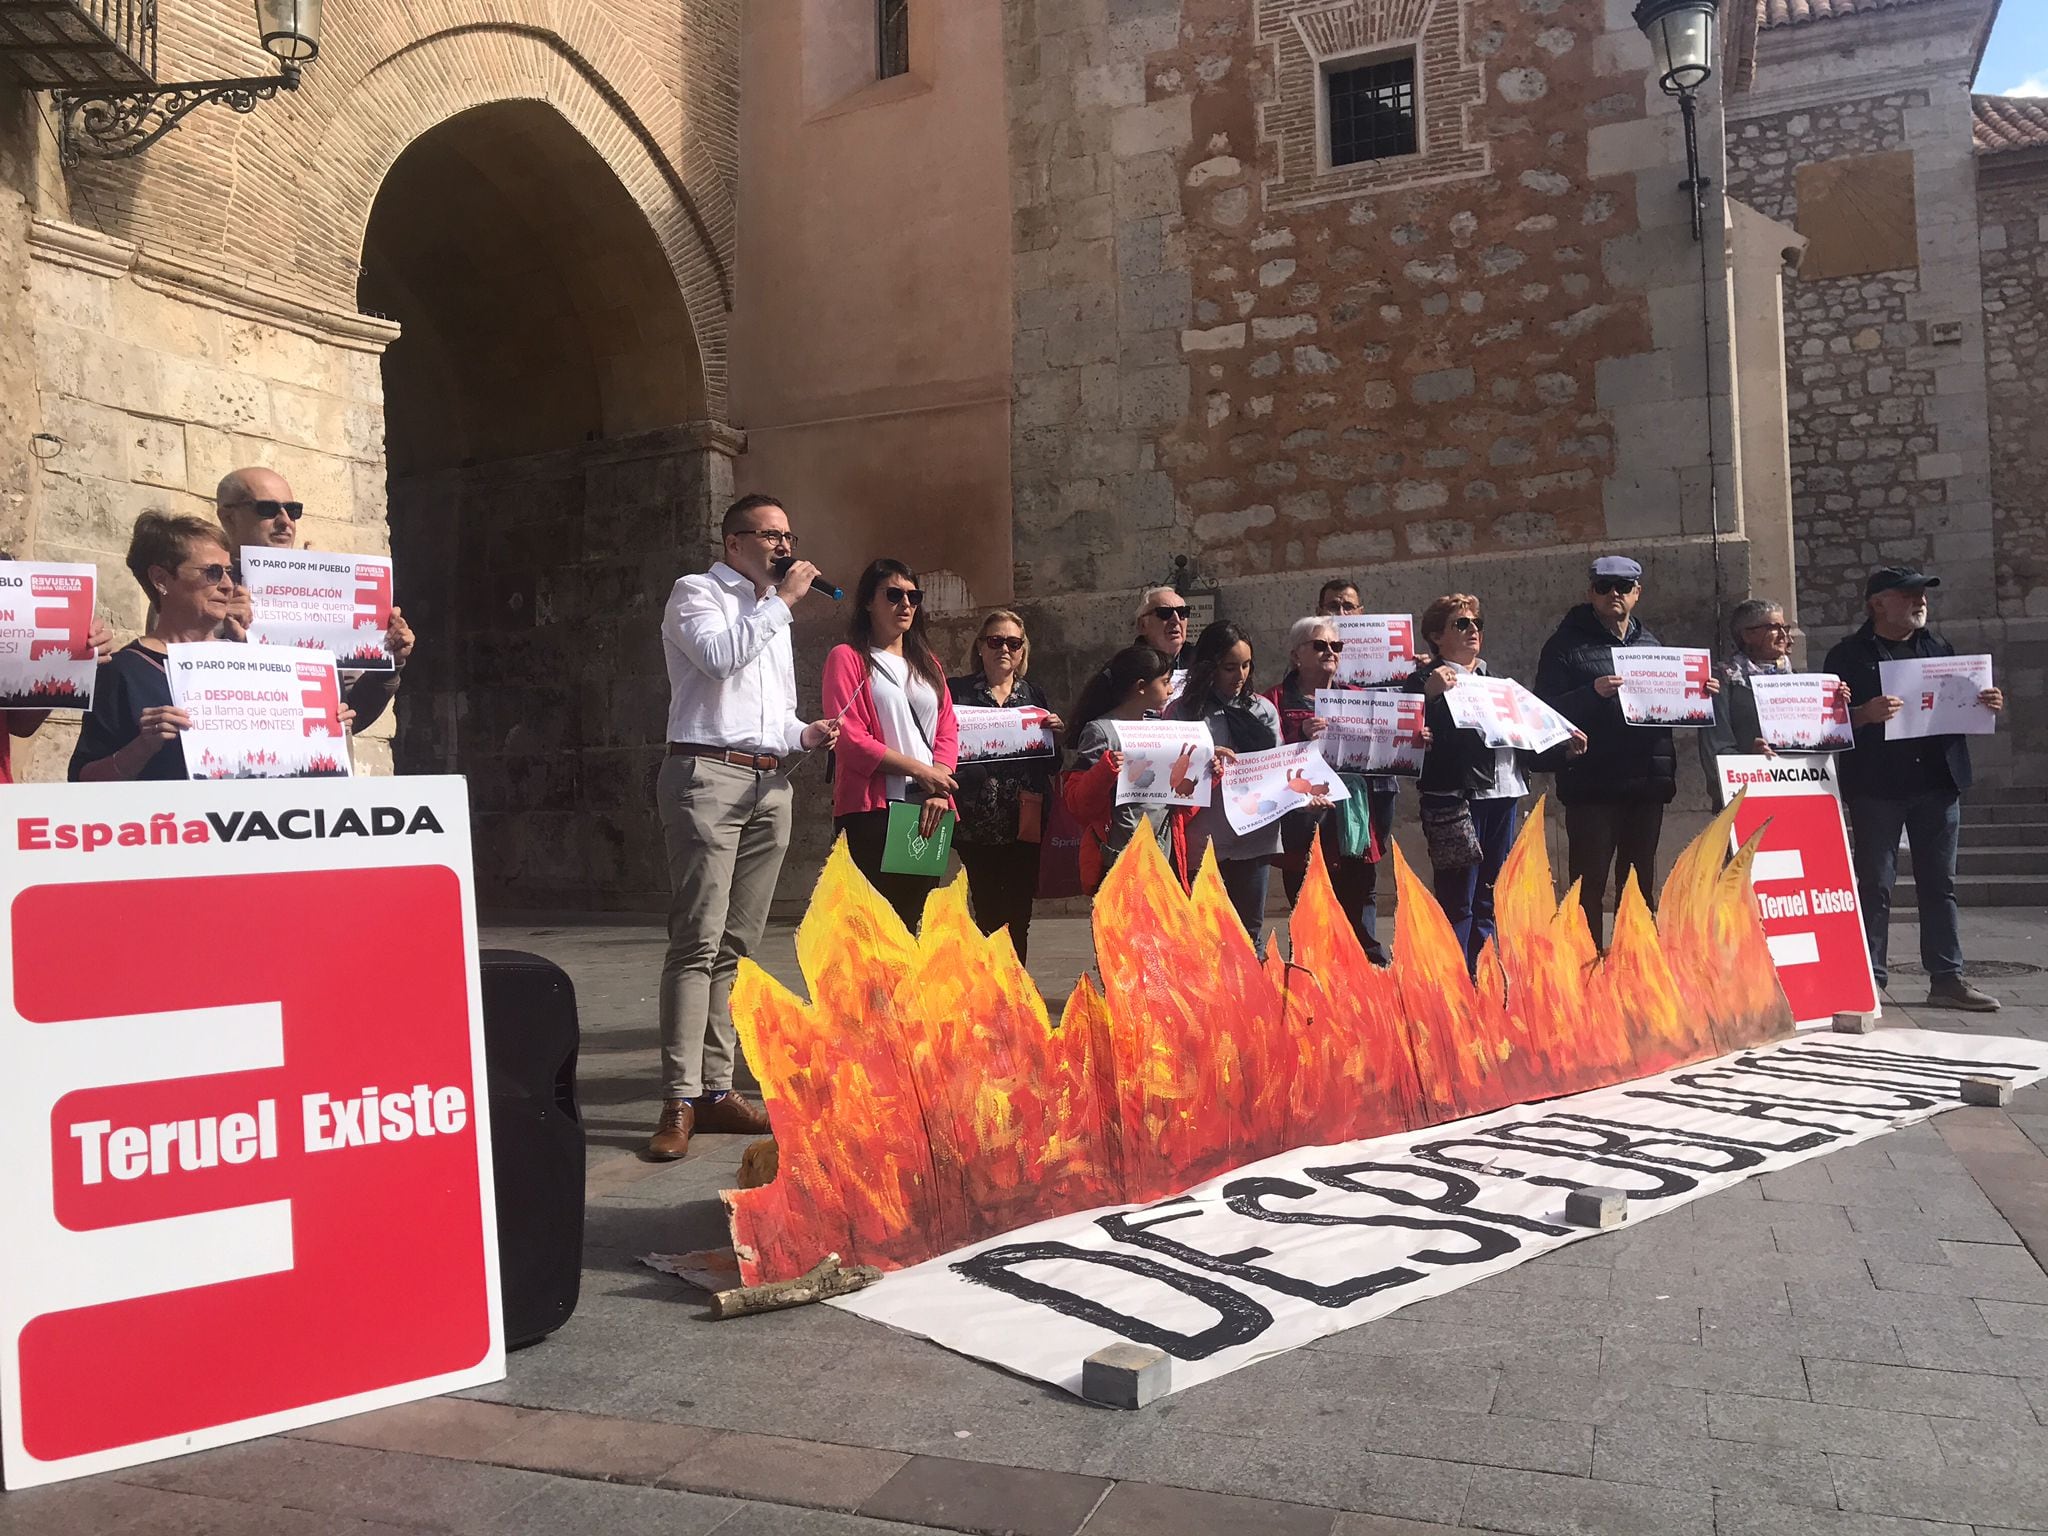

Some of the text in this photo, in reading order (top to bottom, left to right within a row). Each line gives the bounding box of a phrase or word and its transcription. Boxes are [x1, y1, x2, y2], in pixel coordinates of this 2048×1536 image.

[248, 558, 260, 568] YO
[262, 560, 287, 569] PARO
[288, 562, 306, 570] POR
[319, 564, 350, 574] PUEBLO
[266, 585, 342, 598] DESPOBLACIÓN
[261, 598, 270, 608] la
[272, 599, 298, 608] llama
[300, 602, 320, 612] que
[322, 604, 355, 613] quema
[304, 613, 346, 624] MONTES!
[1340, 636, 1382, 644] SPOBLACIÓN
[178, 661, 292, 672] YO PARO POR MI PUEBLO
[182, 689, 288, 702] ¡La DESPOBLACIÓN
[188, 705, 304, 718] es la llama que quema
[250, 720, 295, 731] MONTES!
[960, 720, 1017, 731] ESTROS MONTES!
[1331, 716, 1388, 726] DESPOBLACIÓN
[1261, 754, 1280, 762] CABRAS
[1225, 764, 1270, 776] FUNCIONARIAS
[1284, 756, 1308, 766] LIMPIEN
[1239, 775, 1262, 784] MONTES
[1727, 768, 1830, 784] EspañaVACIADA
[17, 805, 444, 852] EspañaVACIADA
[1758, 888, 1855, 920] Teruel Existe
[70, 1084, 467, 1186] Teruel Existe
